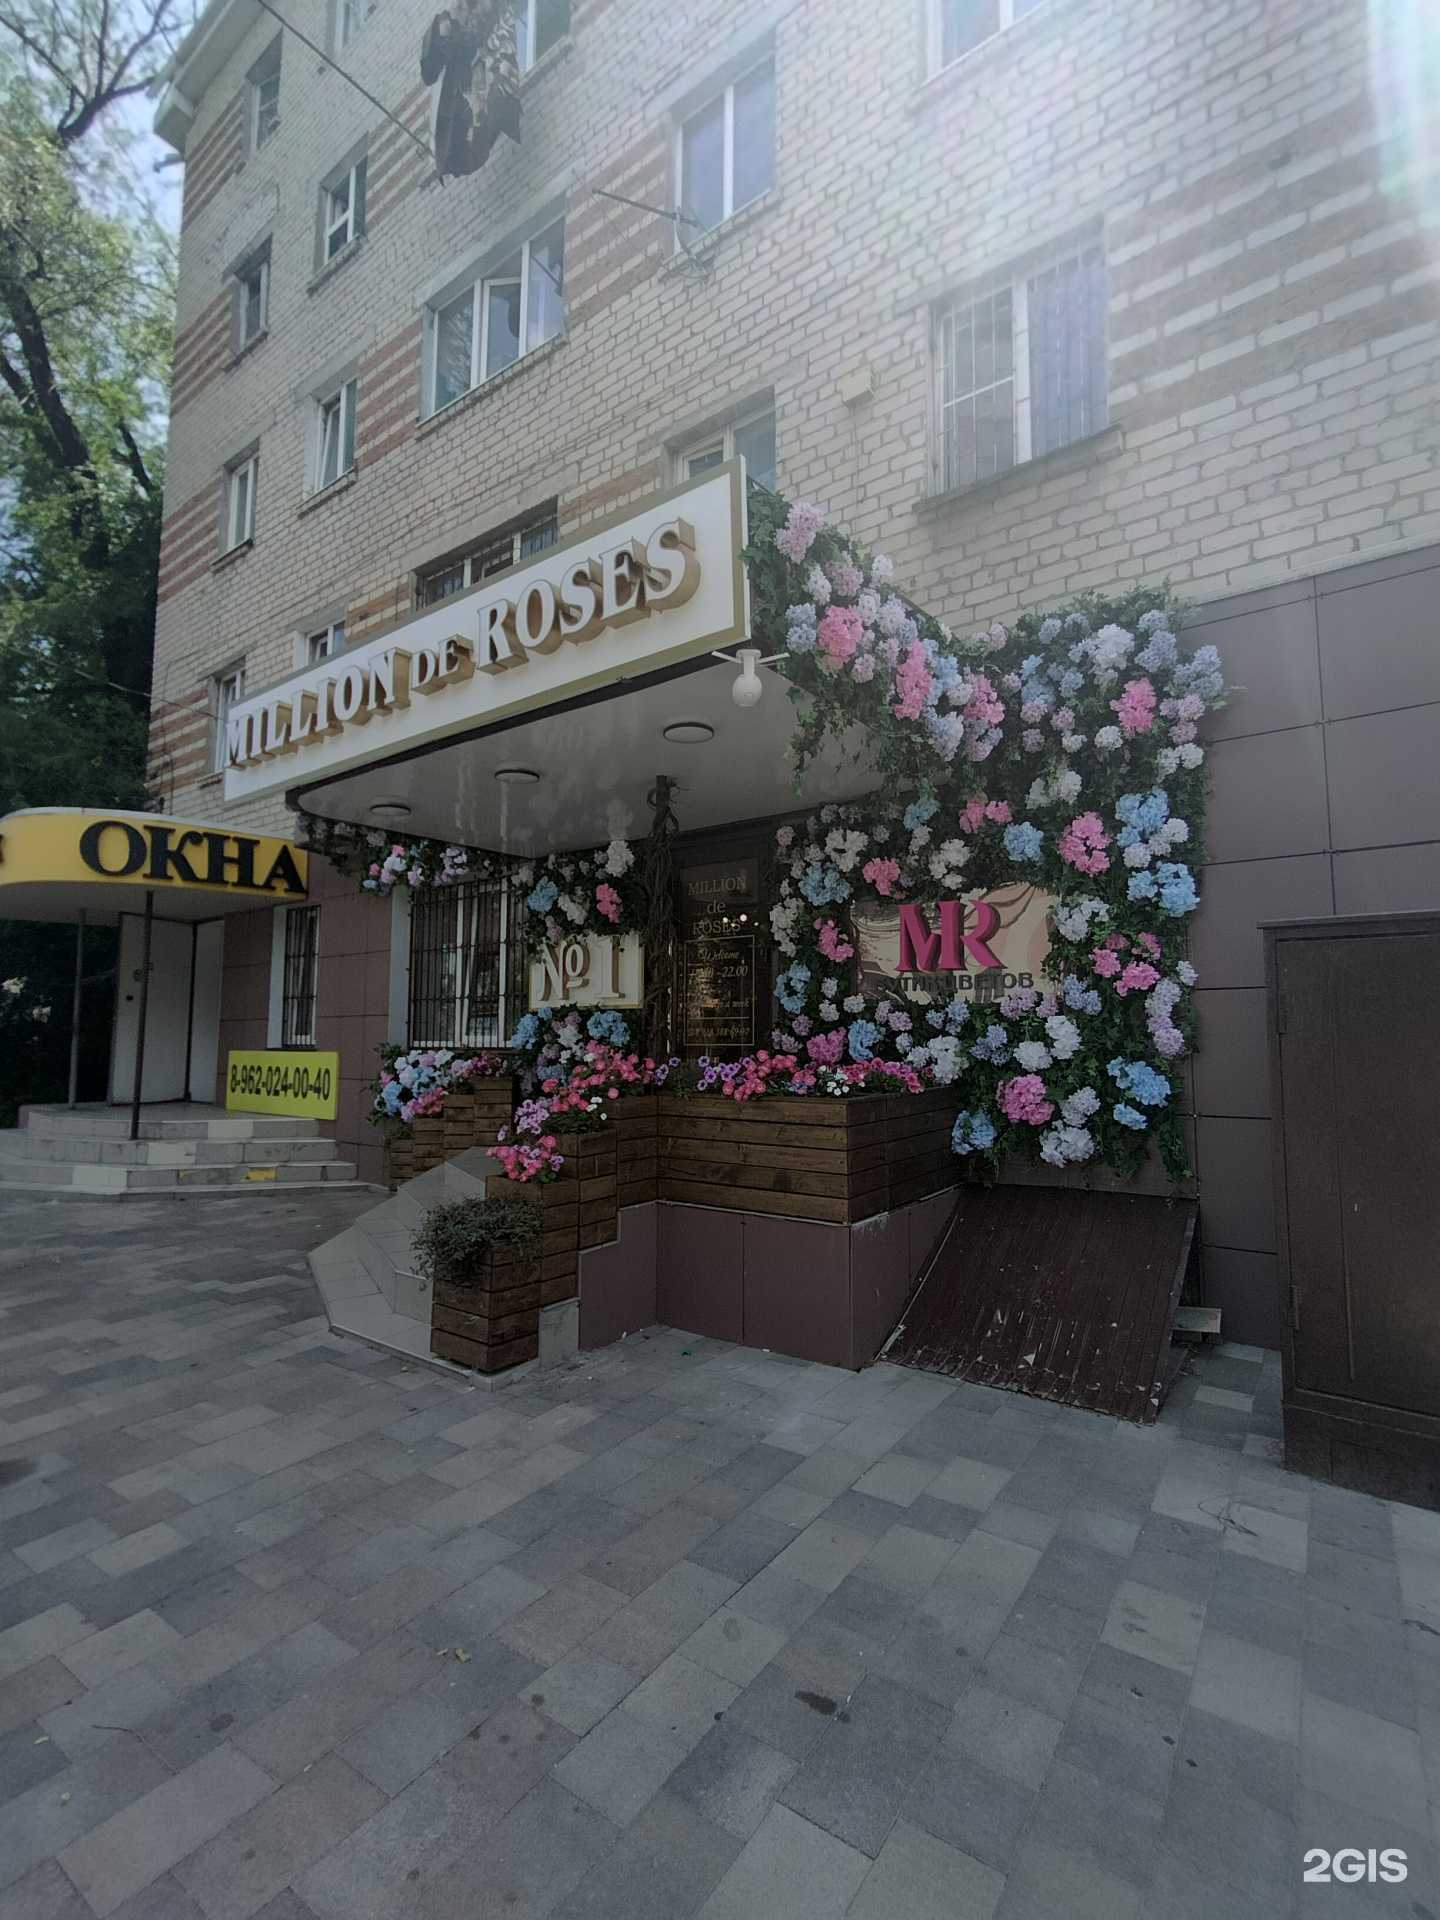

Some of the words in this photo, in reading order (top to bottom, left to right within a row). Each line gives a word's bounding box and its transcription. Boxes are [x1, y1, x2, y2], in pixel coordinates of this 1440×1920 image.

[225, 646, 406, 770] MILLION
[411, 634, 470, 692] DE
[477, 517, 698, 672] ROSES
[79, 820, 308, 895] ОКНА
[688, 876, 747, 896] MILLION
[706, 898, 727, 914] de
[693, 917, 741, 936] ROSES
[896, 899, 1007, 972] MR
[230, 1063, 331, 1101] 8-962-024-00-40
